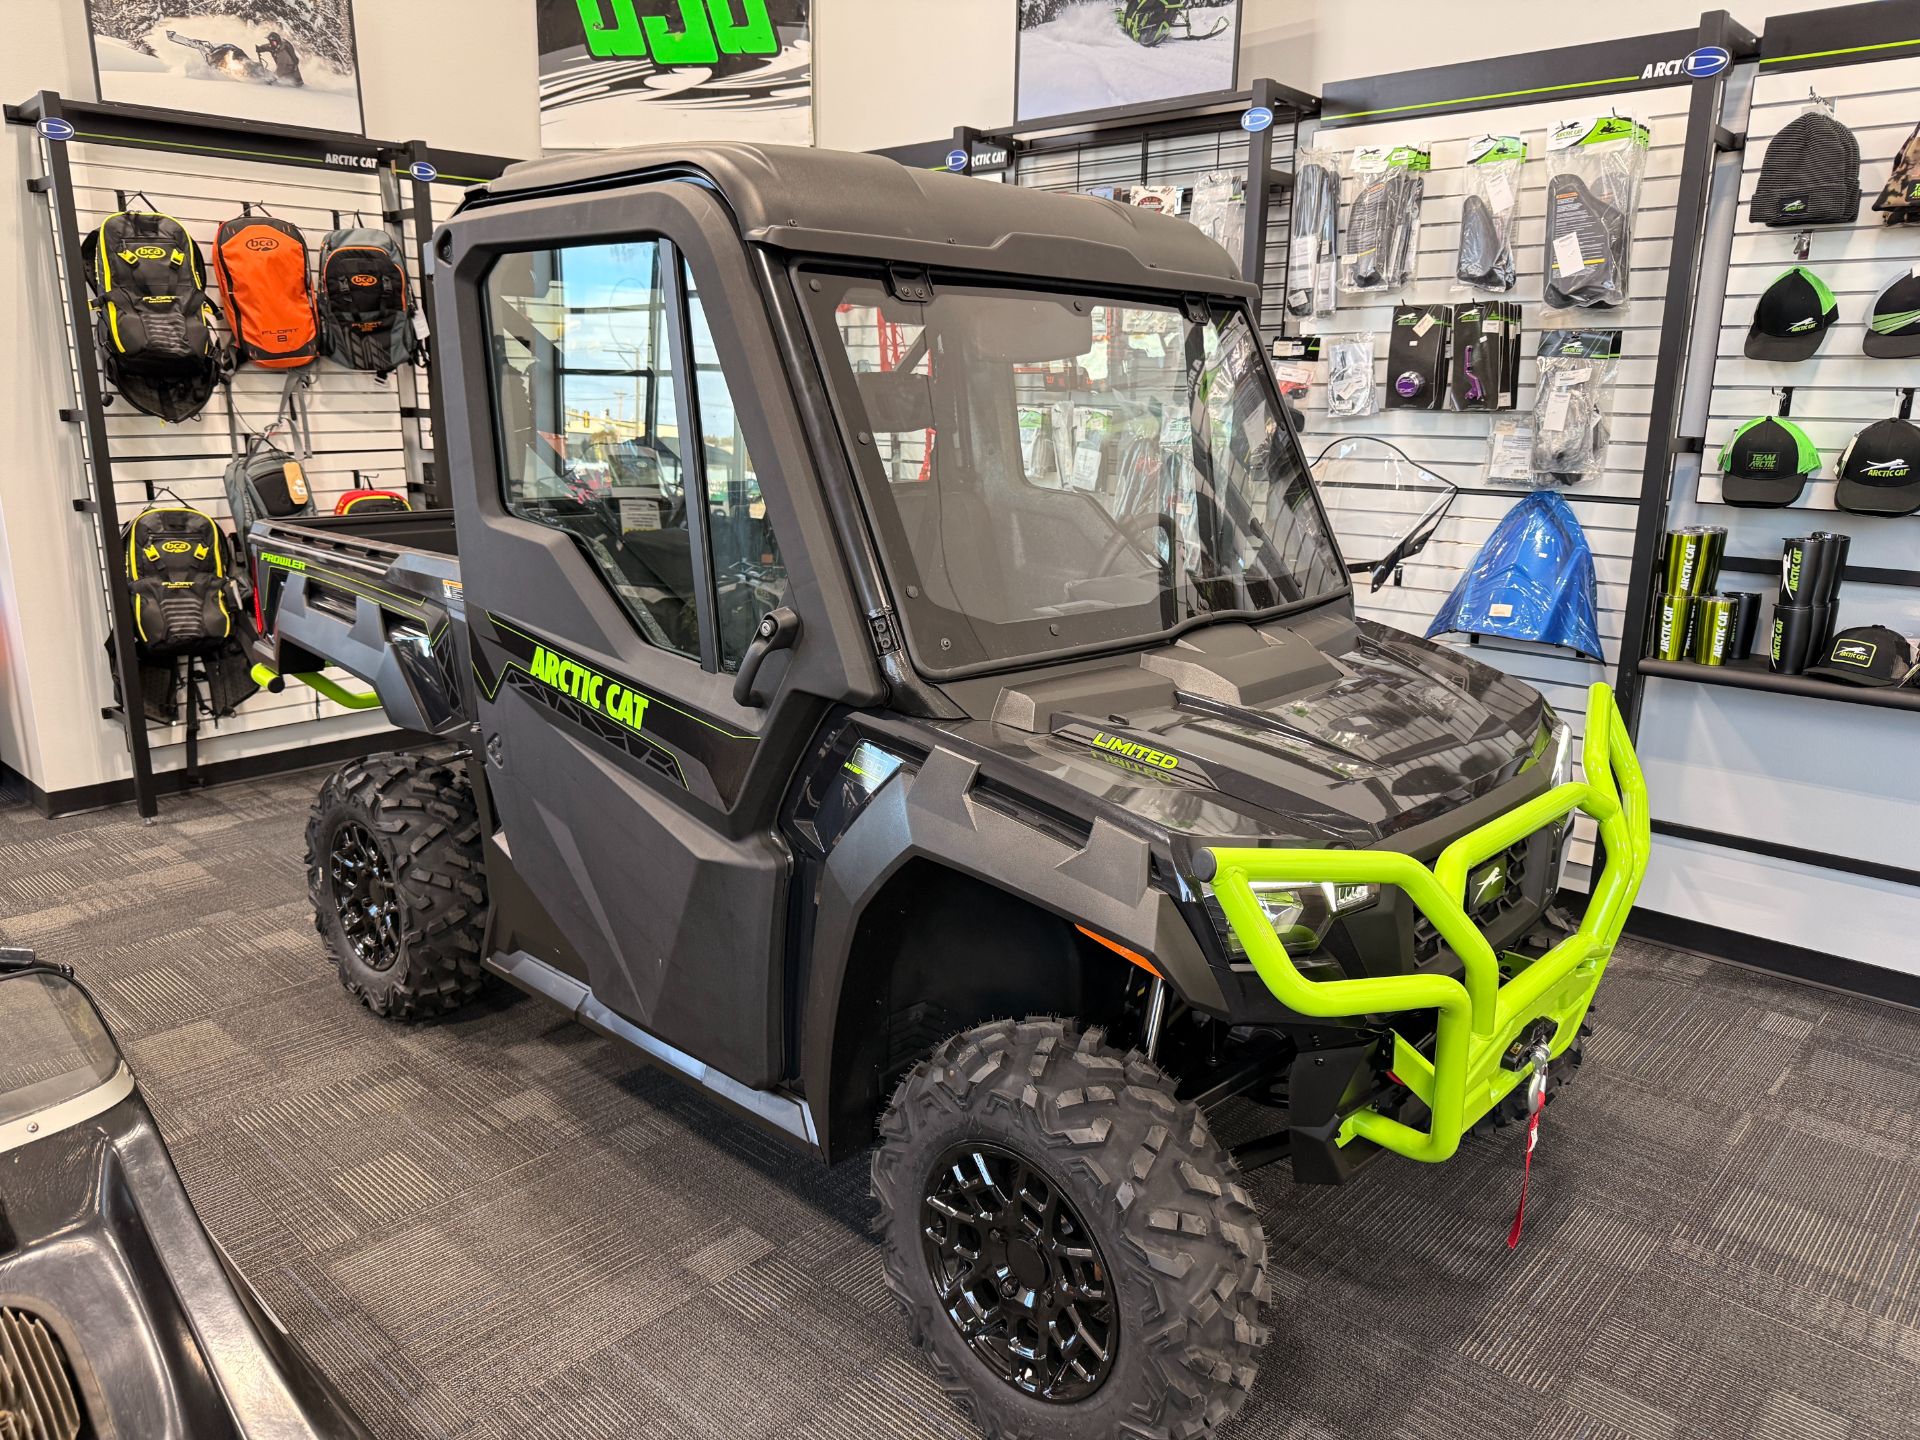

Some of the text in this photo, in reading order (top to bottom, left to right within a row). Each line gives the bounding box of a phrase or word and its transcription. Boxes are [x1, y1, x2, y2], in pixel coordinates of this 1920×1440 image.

[1641, 58, 1684, 79] ARCT
[325, 153, 378, 168] ARCTIC CAT
[971, 151, 1007, 167] RCTIC CAT
[262, 327, 299, 335] FLOAT
[1791, 325, 1808, 333] ARCTIC
[1748, 460, 1776, 468] ARCTIC
[1752, 453, 1776, 461] TEAM
[1867, 468, 1910, 477] ARCTIC CAT
[1685, 542, 1696, 559] CAT
[261, 552, 306, 571] PROWLER
[1789, 547, 1803, 592] ARCTIC CAT
[1680, 559, 1694, 591] ARCTIC
[1660, 605, 1674, 653] ARCTIC CAT
[1713, 609, 1729, 658] ARCTIC CAT
[1772, 617, 1784, 661] ARCTIC CAT
[1839, 651, 1869, 661] ARCTIC CAT
[530, 645, 649, 730] ARCTIC CAT
[1092, 732, 1179, 769] LIMITED
